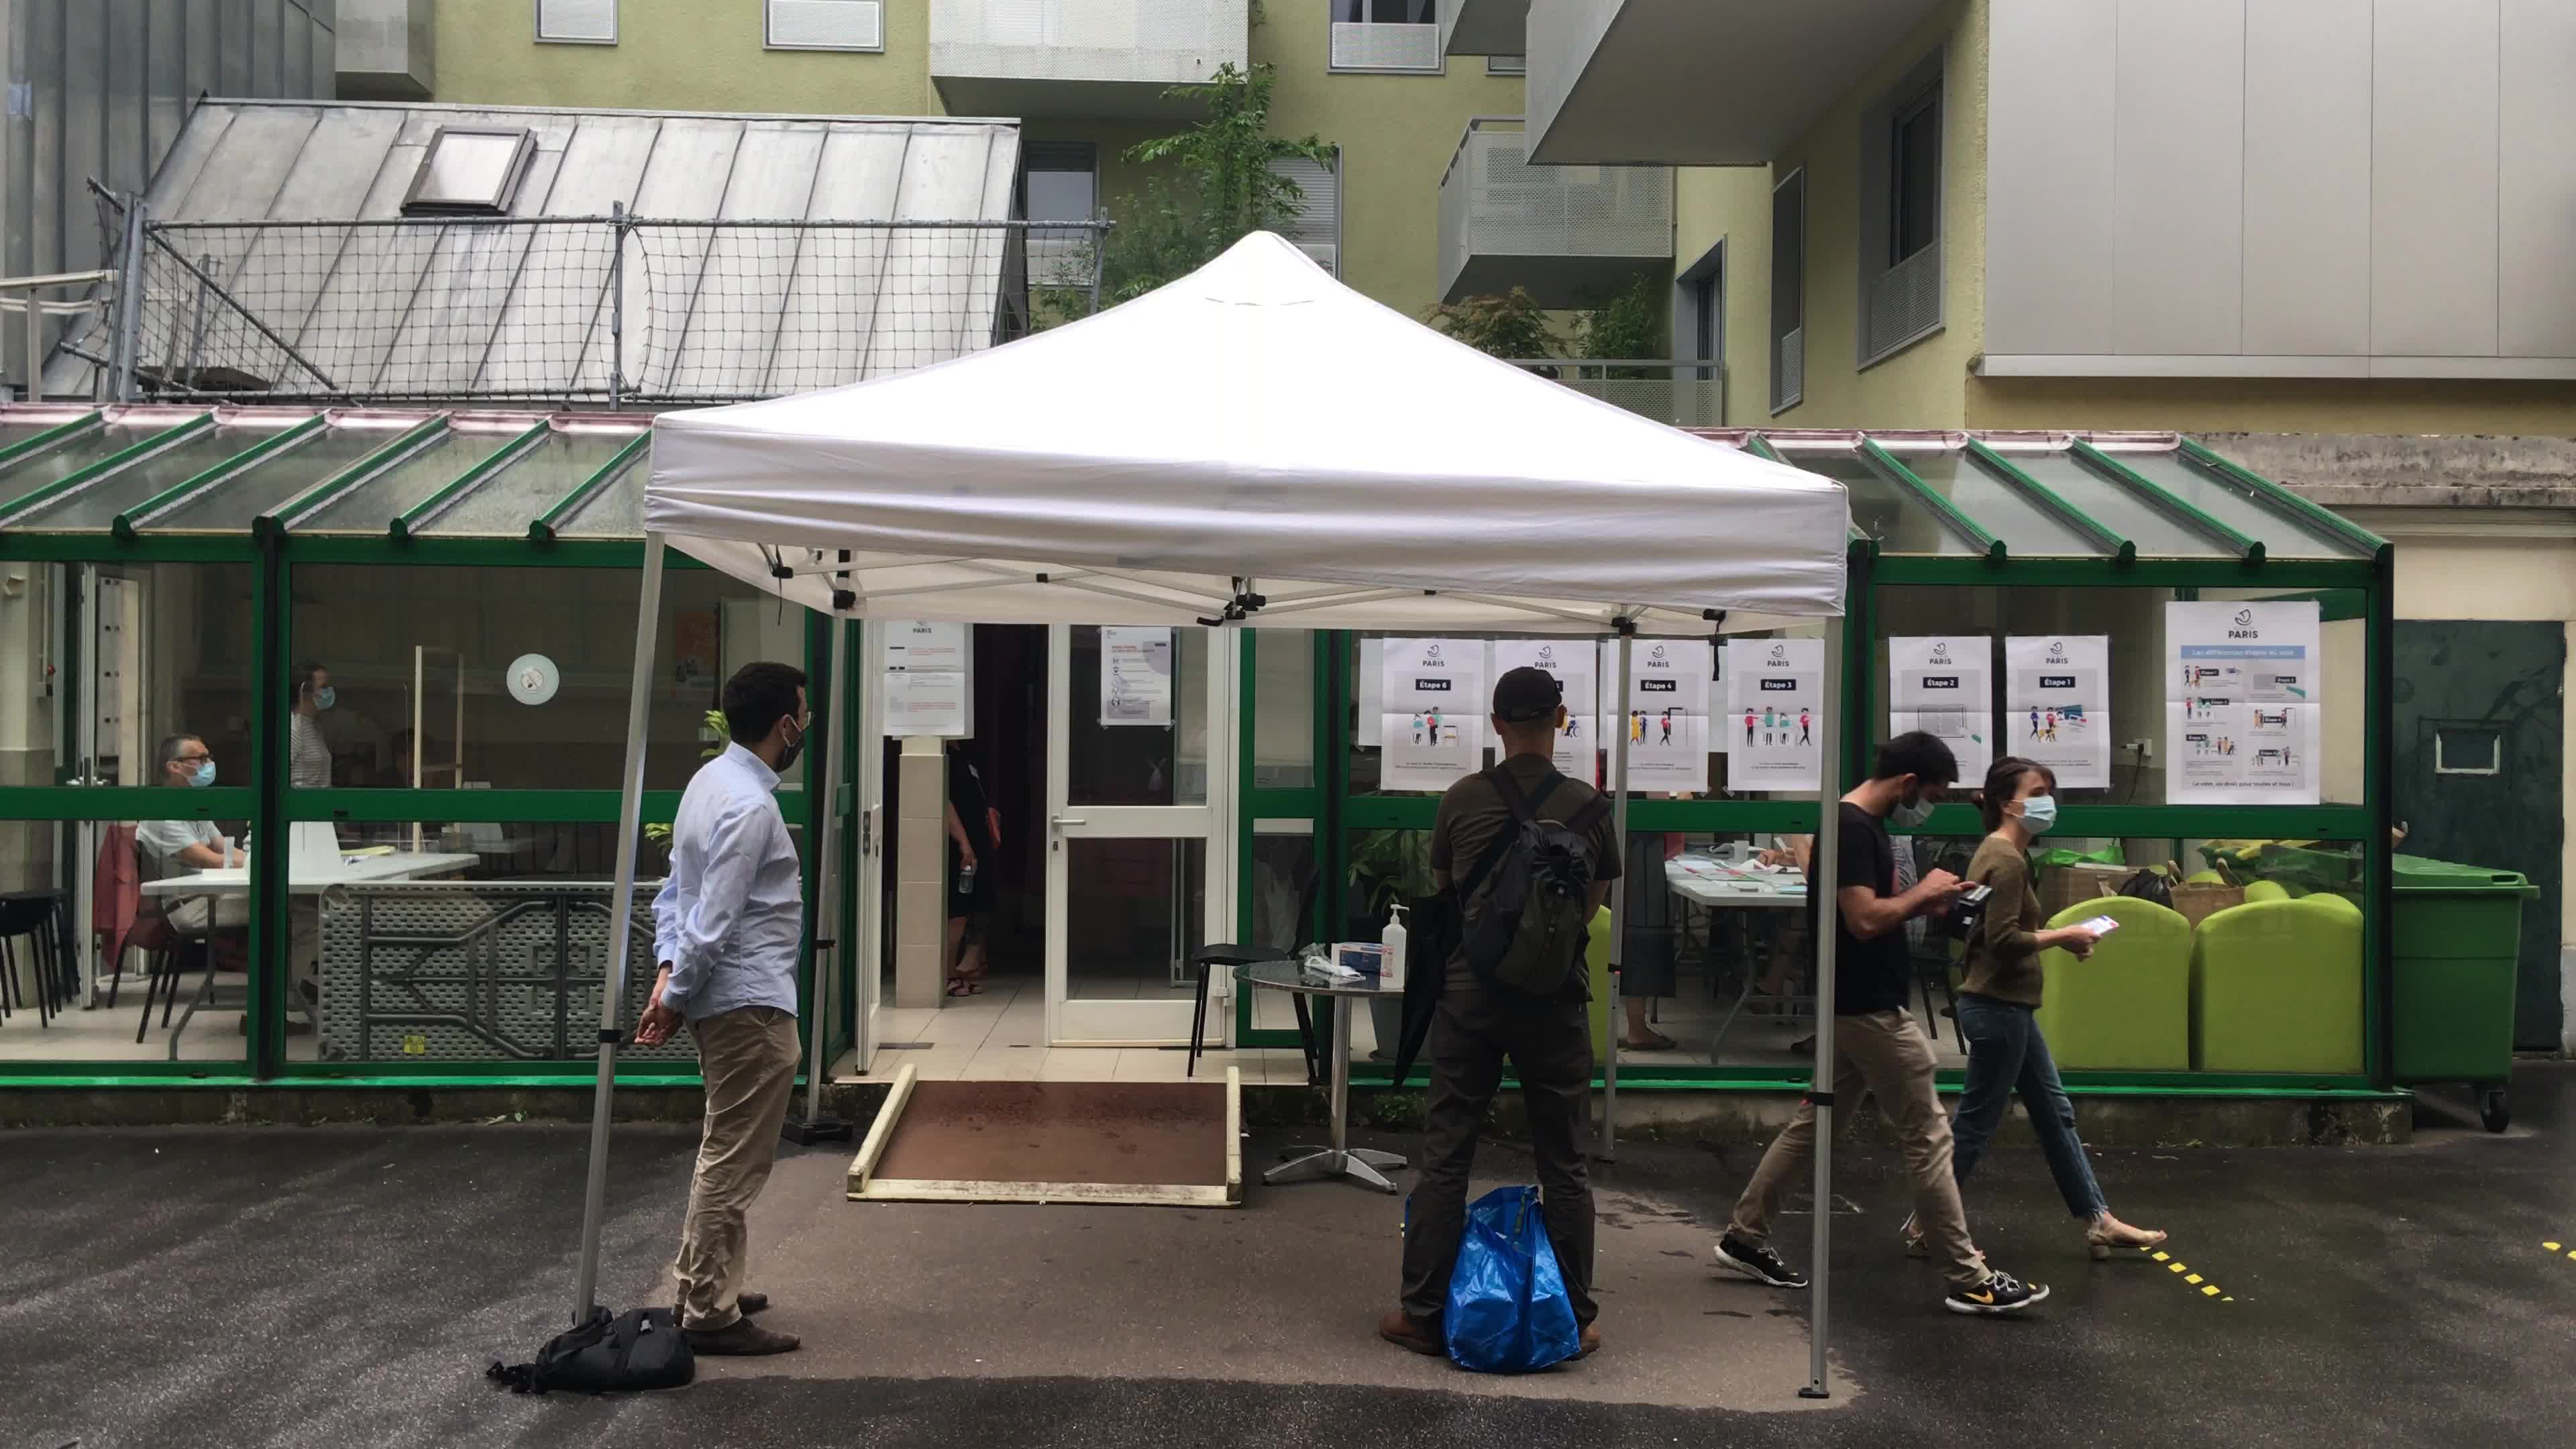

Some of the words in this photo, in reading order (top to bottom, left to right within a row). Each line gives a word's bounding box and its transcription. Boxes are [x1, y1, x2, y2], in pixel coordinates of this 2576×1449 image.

[2229, 631, 2259, 639] PARIS
[1419, 680, 1441, 689] Étape
[1645, 682, 1666, 690] Étape
[1927, 678, 1949, 687] Étape
[2044, 678, 2065, 686] Étape
